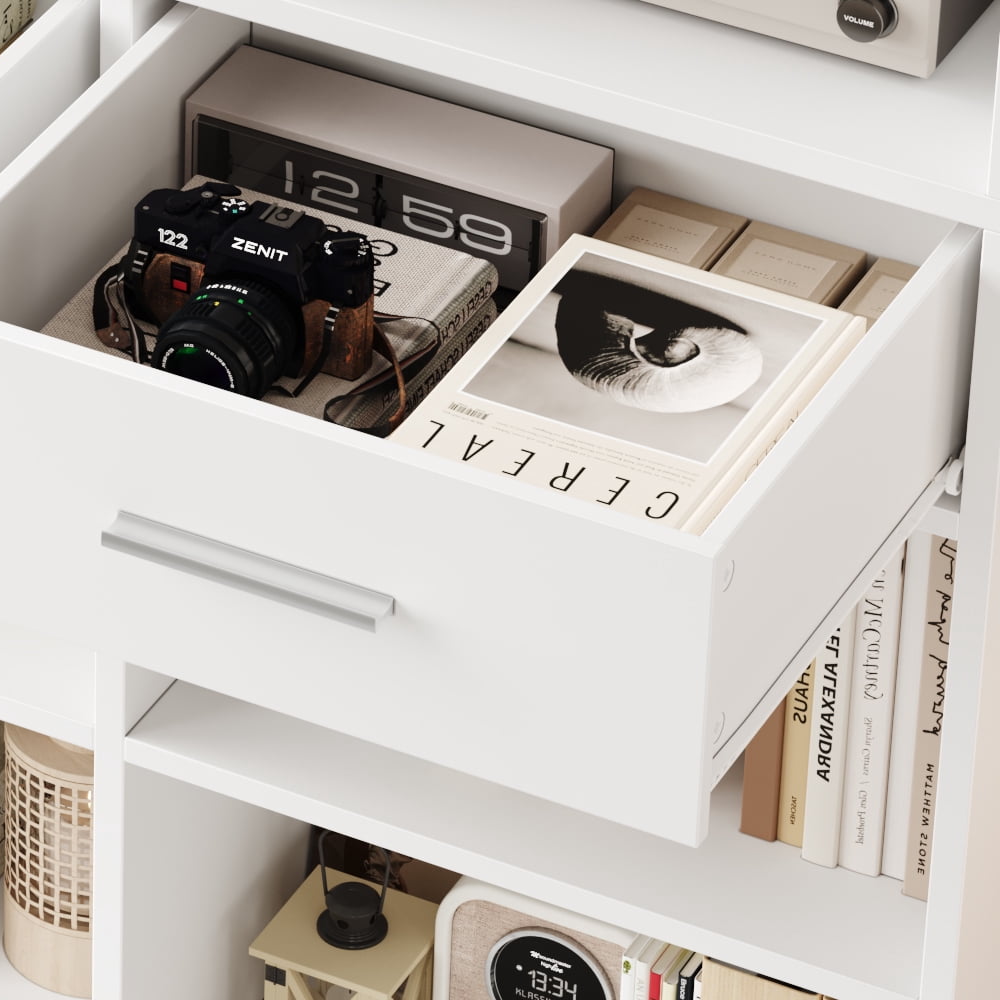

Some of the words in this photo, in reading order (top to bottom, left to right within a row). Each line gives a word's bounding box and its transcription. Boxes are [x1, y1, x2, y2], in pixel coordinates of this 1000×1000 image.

[843, 13, 875, 29] VOLUME
[284, 160, 360, 214] 12
[402, 194, 513, 256] 59
[157, 227, 189, 251] 122
[230, 236, 289, 263] ZENIT
[422, 420, 680, 520] CEREAL
[527, 968, 578, 1000] 13:34
